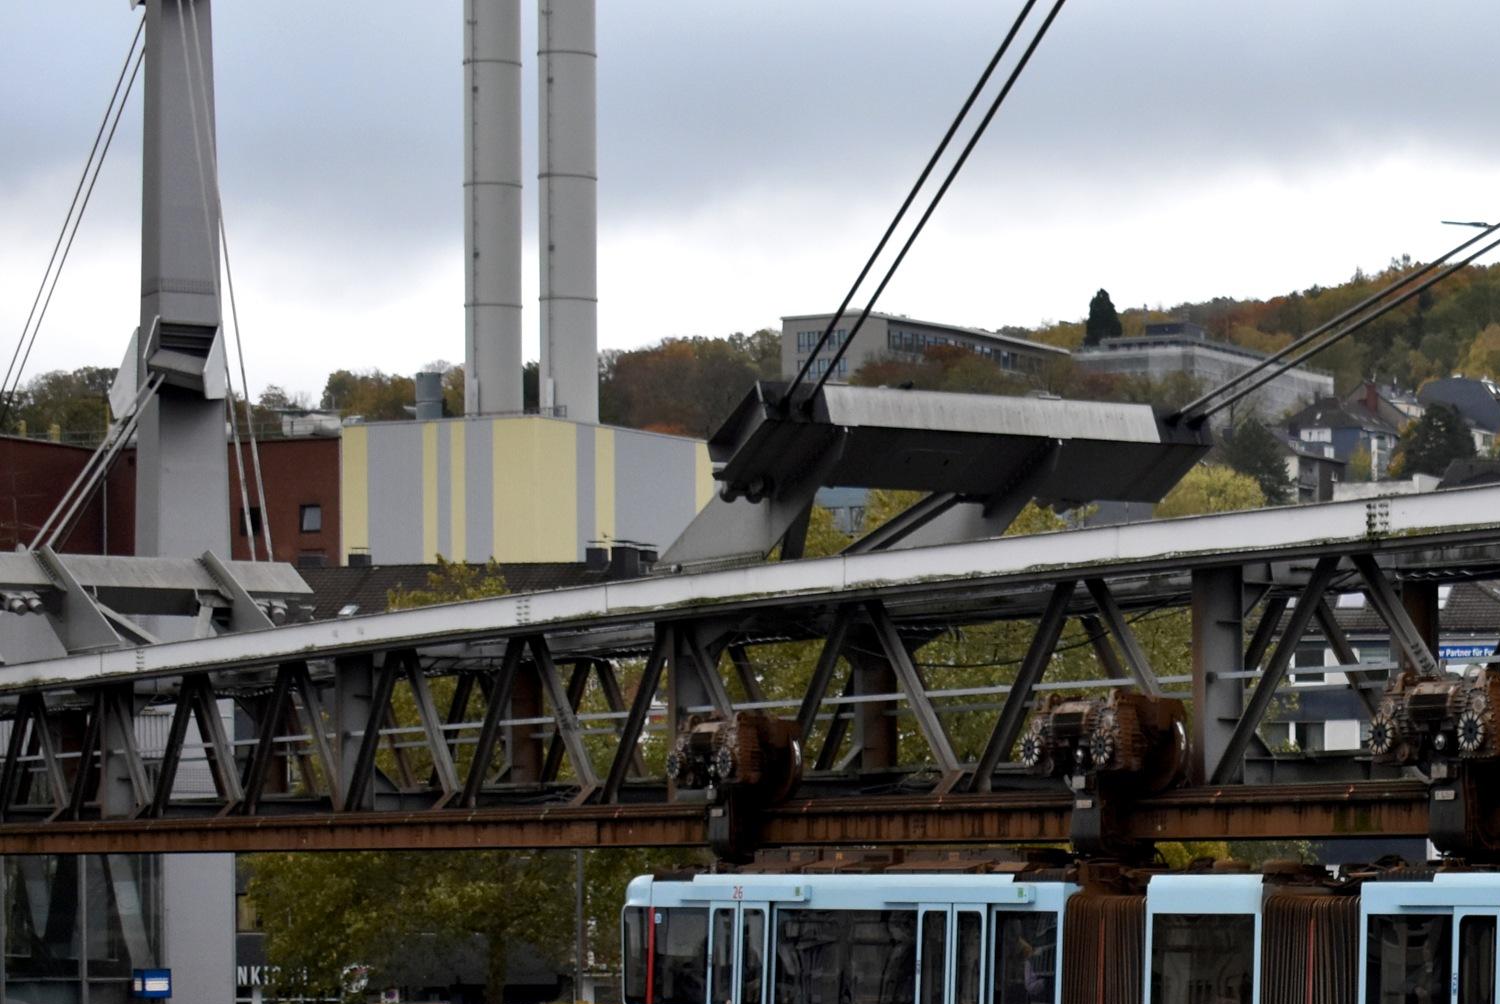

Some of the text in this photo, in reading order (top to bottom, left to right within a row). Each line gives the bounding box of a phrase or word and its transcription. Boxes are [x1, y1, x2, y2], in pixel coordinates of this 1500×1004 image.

[1446, 648, 1472, 657] Partner
[1473, 648, 1483, 657] für
[733, 886, 743, 899] 26
